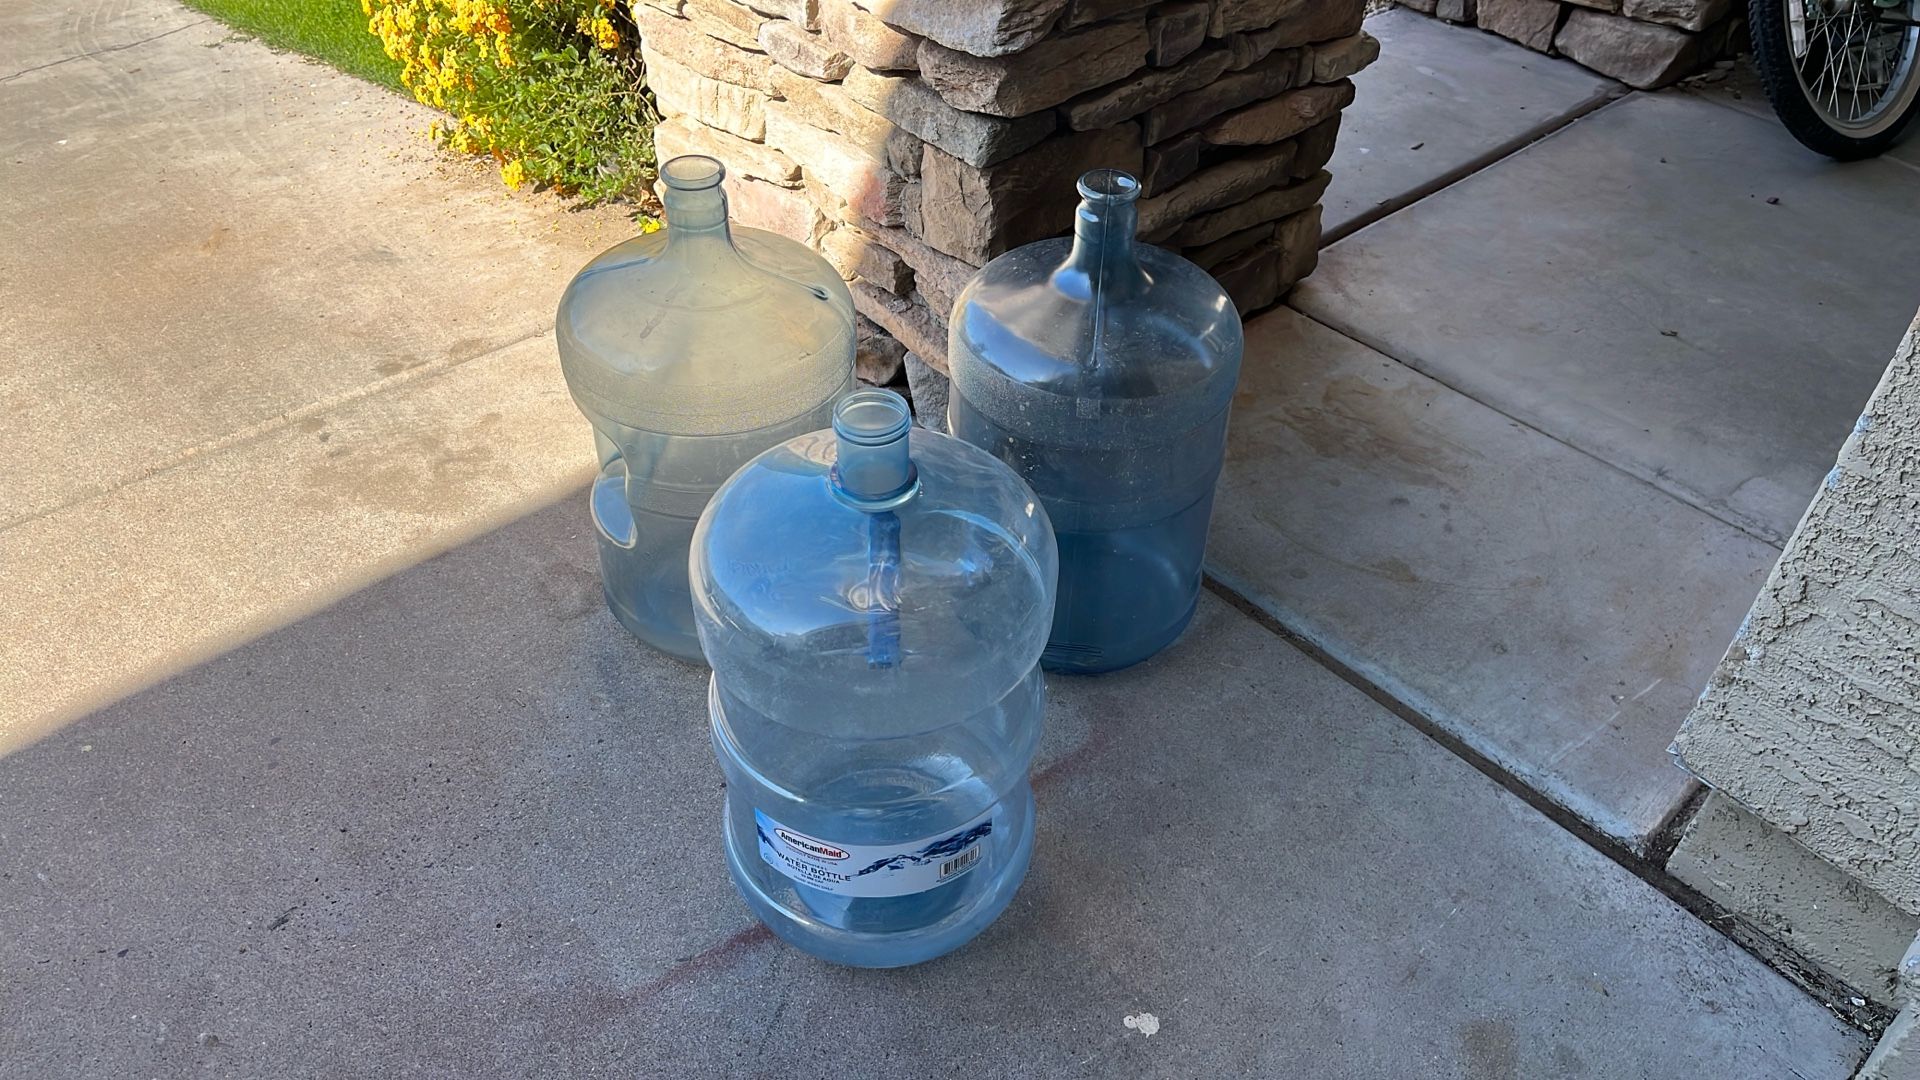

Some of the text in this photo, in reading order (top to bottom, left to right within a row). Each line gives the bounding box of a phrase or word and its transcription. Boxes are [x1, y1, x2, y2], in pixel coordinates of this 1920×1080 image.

[780, 831, 842, 859] AmericanMaid
[777, 850, 808, 872] WATER
[810, 866, 852, 882] BOTTLE
[786, 862, 812, 877] BOTELLA
